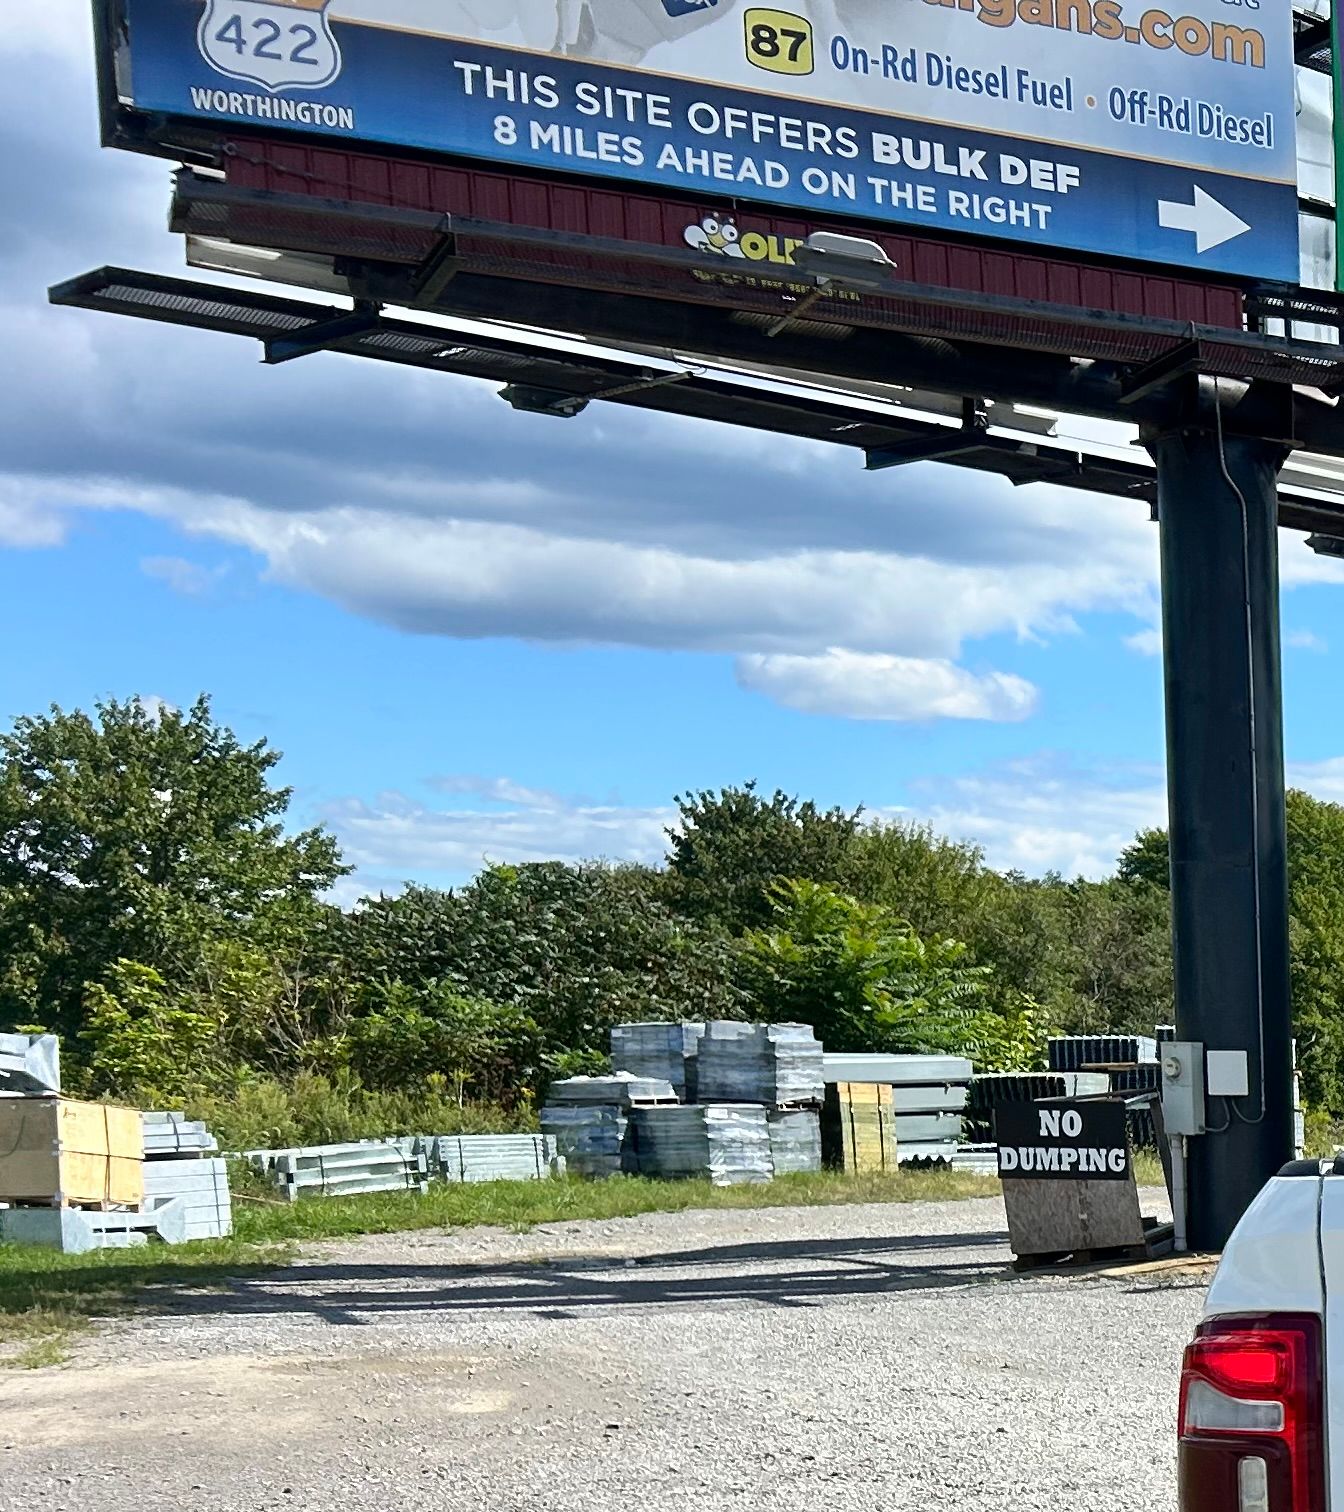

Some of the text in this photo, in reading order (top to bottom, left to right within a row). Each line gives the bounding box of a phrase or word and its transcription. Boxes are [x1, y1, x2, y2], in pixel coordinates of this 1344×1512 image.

[215, 14, 318, 65] 422
[750, 24, 807, 62] 87
[921, 0, 1265, 68] gans.com
[190, 86, 354, 130] WORTHINGTON
[831, 35, 1272, 147] On-Rd Diesel Fuel Off-Rd Diesel
[454, 60, 1080, 194] THIS SITE OFFERS BULK DEF
[494, 115, 1052, 230] 8 MILES AHEAD ON THE RIGHT
[1039, 1109, 1082, 1138] NO
[1000, 1146, 1126, 1173] DUMPING
